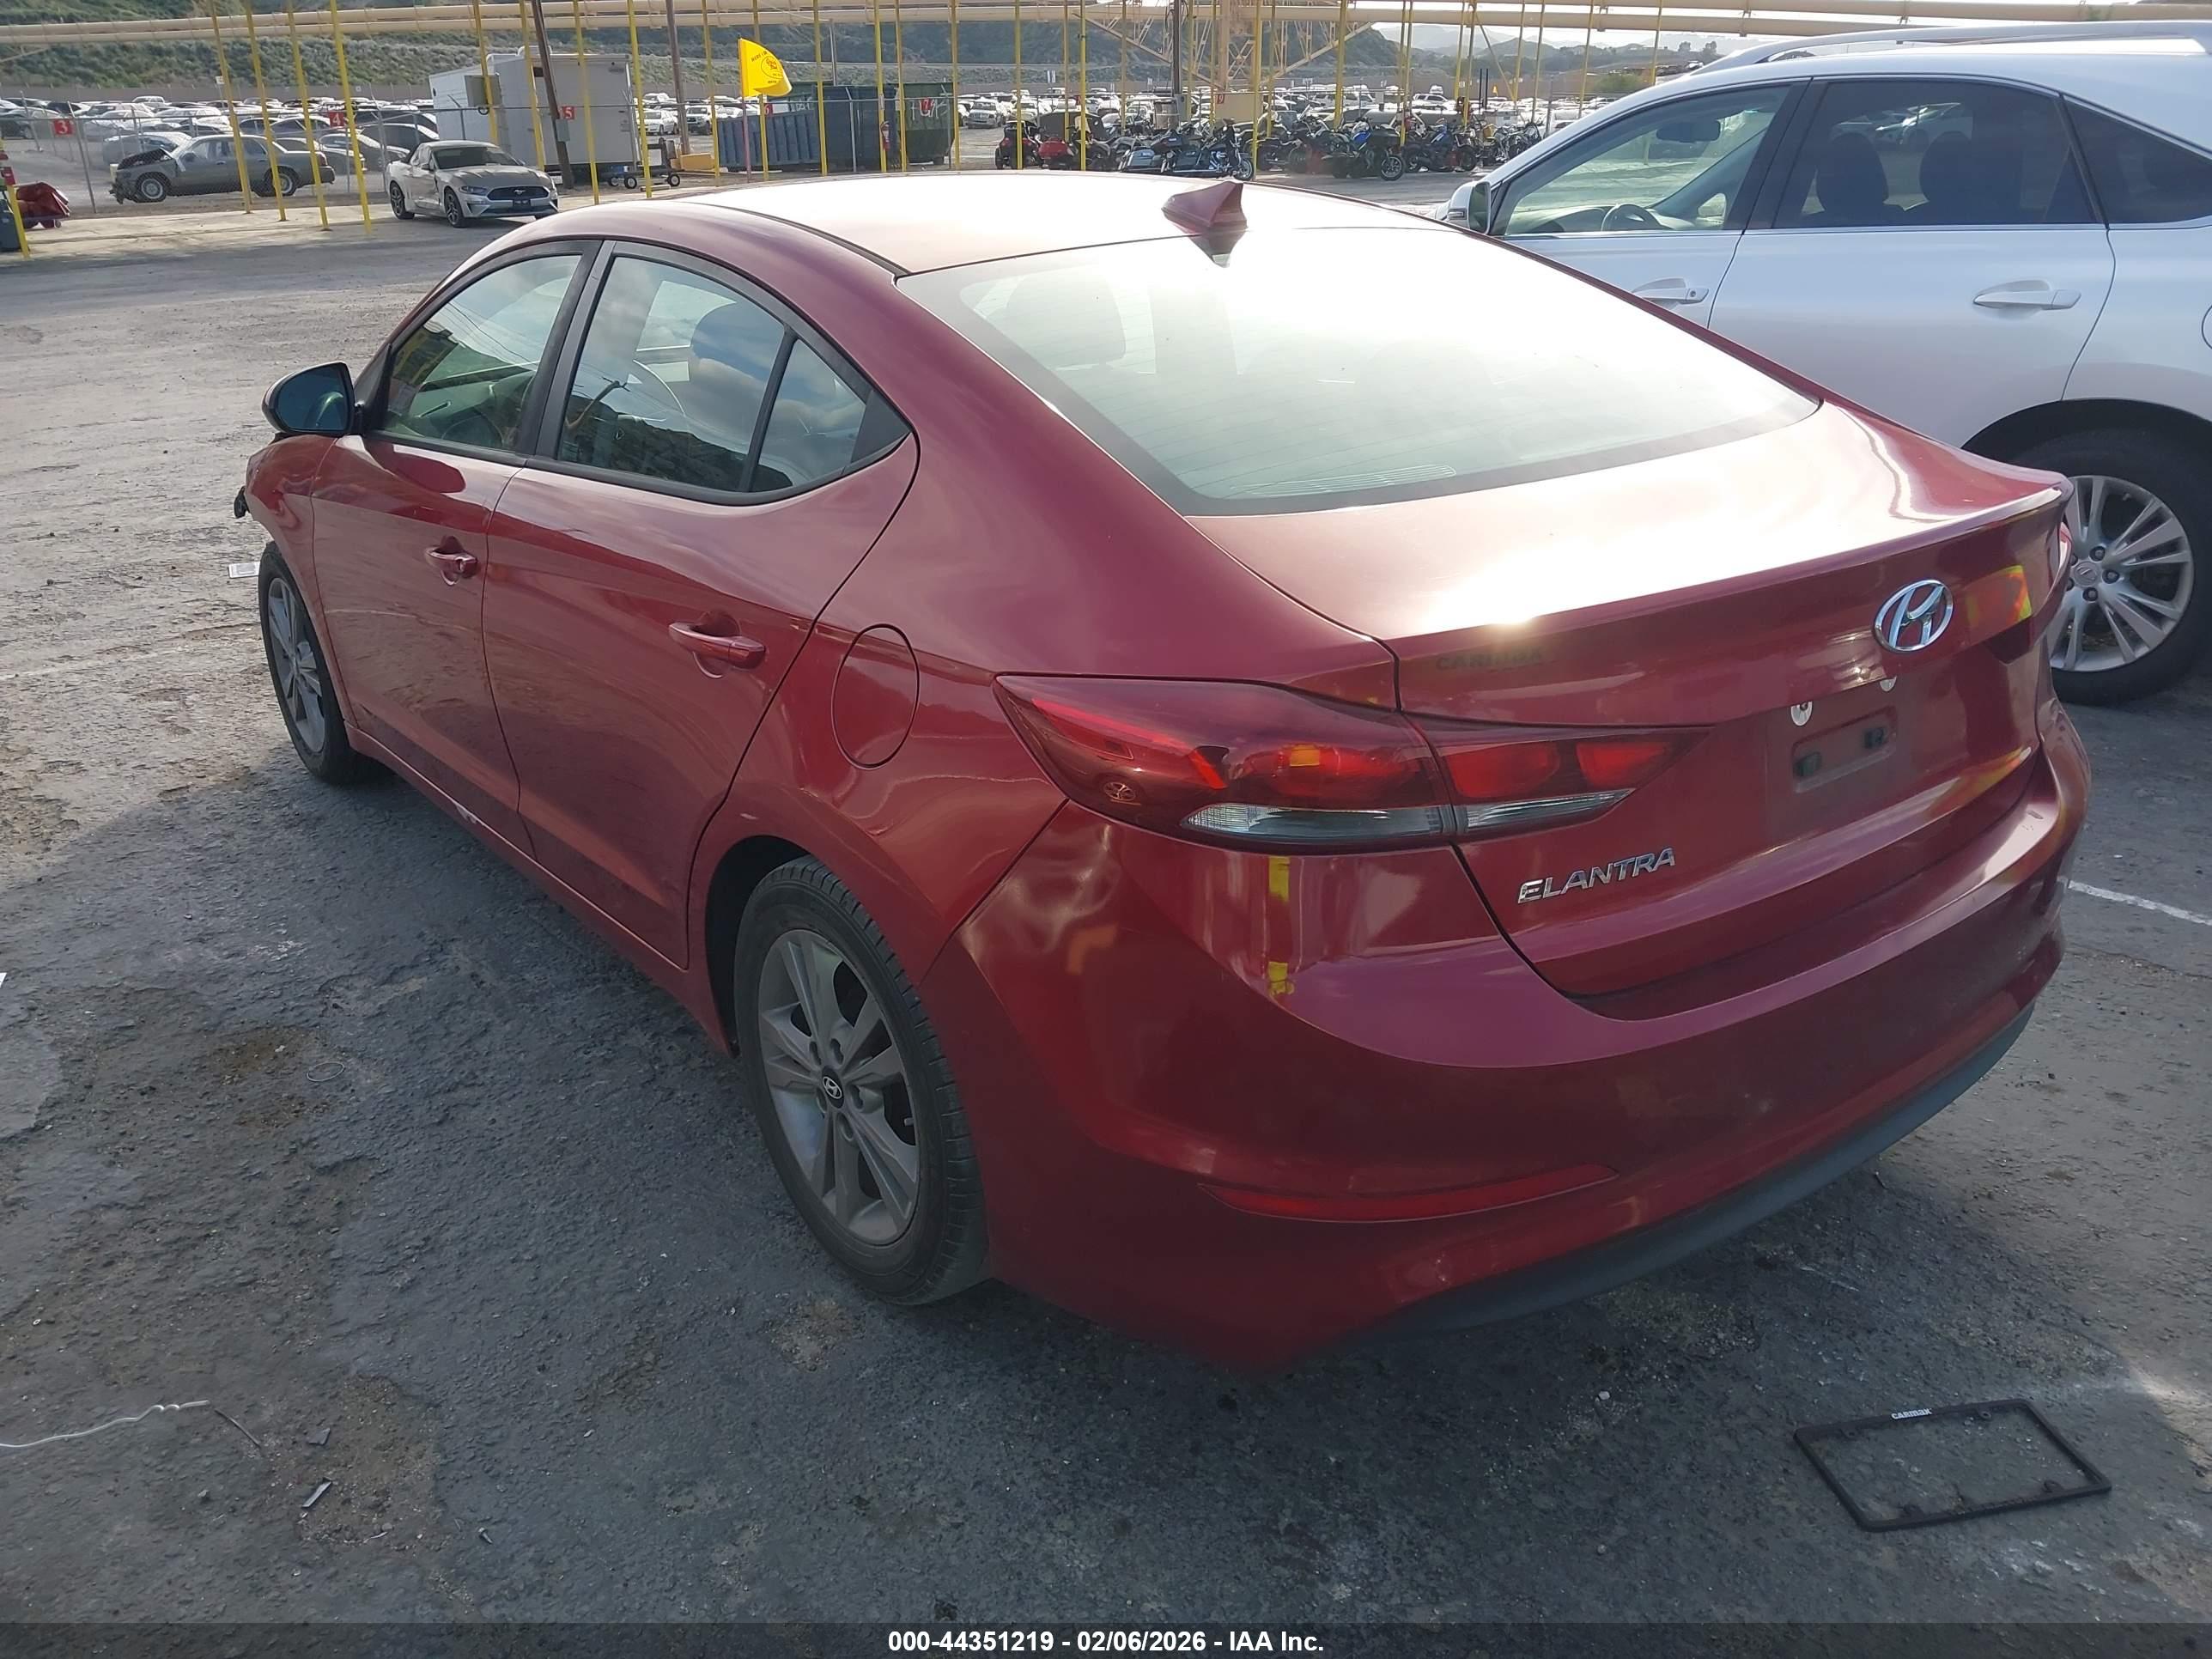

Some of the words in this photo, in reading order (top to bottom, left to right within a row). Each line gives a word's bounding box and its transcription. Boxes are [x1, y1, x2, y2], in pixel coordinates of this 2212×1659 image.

[332, 112, 341, 125] 4
[565, 106, 573, 118] 5
[58, 120, 68, 134] 3
[1518, 848, 1675, 903] ELANTRA
